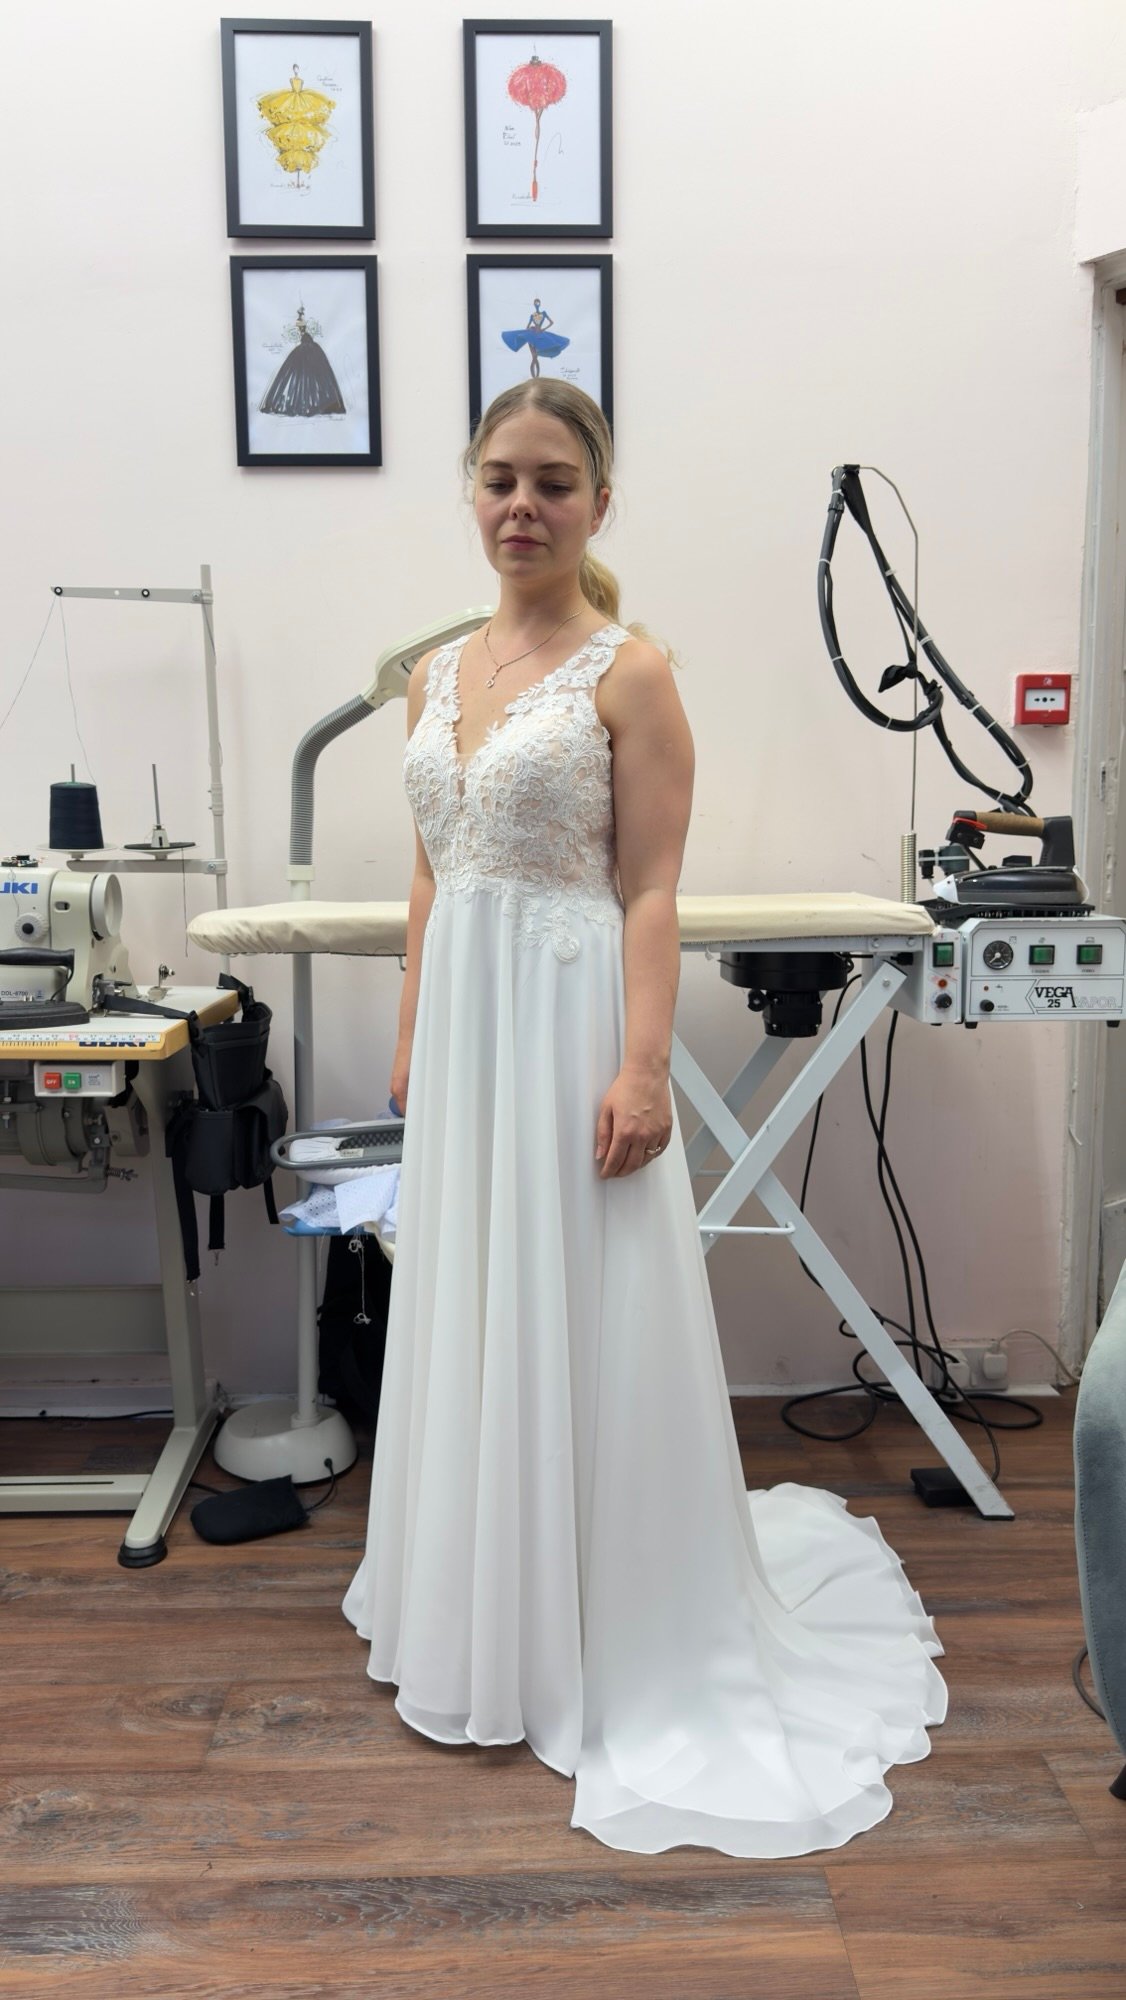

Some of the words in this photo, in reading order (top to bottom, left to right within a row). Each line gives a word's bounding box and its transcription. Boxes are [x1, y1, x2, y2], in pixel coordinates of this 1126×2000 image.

[0, 882, 38, 894] UKI
[1034, 986, 1077, 1008] VEGA
[1047, 999, 1061, 1008] 25
